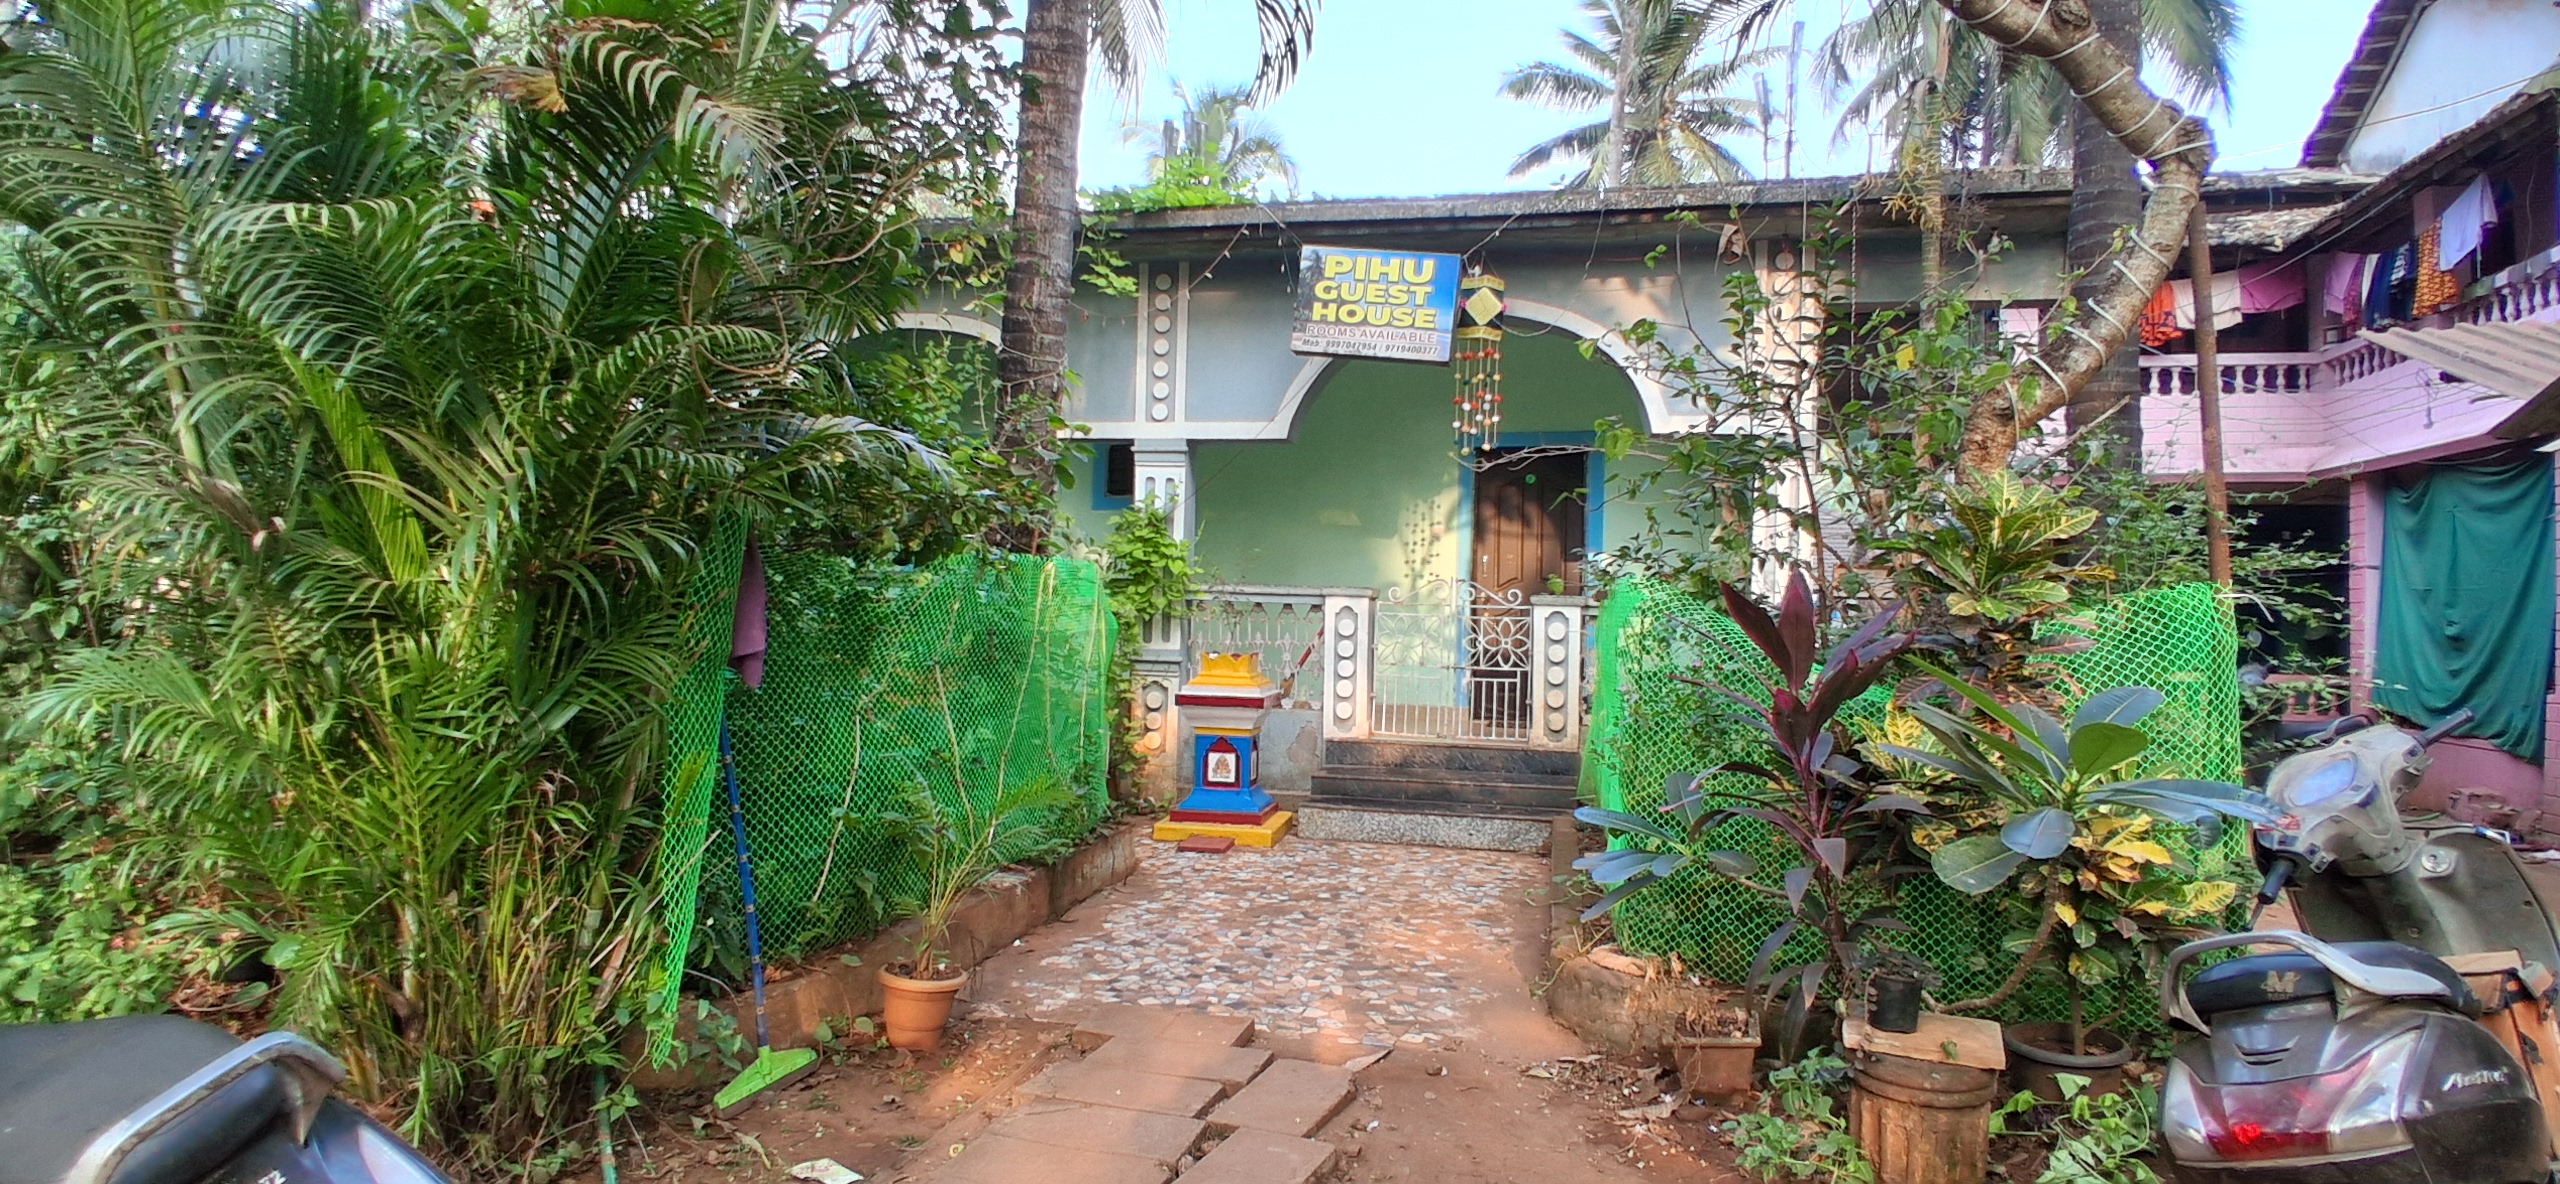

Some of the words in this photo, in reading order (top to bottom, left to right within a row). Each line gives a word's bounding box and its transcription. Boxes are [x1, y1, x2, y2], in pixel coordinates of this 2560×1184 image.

[1324, 254, 1435, 284] PIHU
[1313, 280, 1433, 306] GUEST
[1311, 301, 1438, 329] HOUSE
[1302, 338, 1323, 347] Mob:
[1385, 345, 1439, 355] 9719400377
[1306, 325, 1357, 339] ROOMS
[1360, 329, 1436, 344] AVAILABLE
